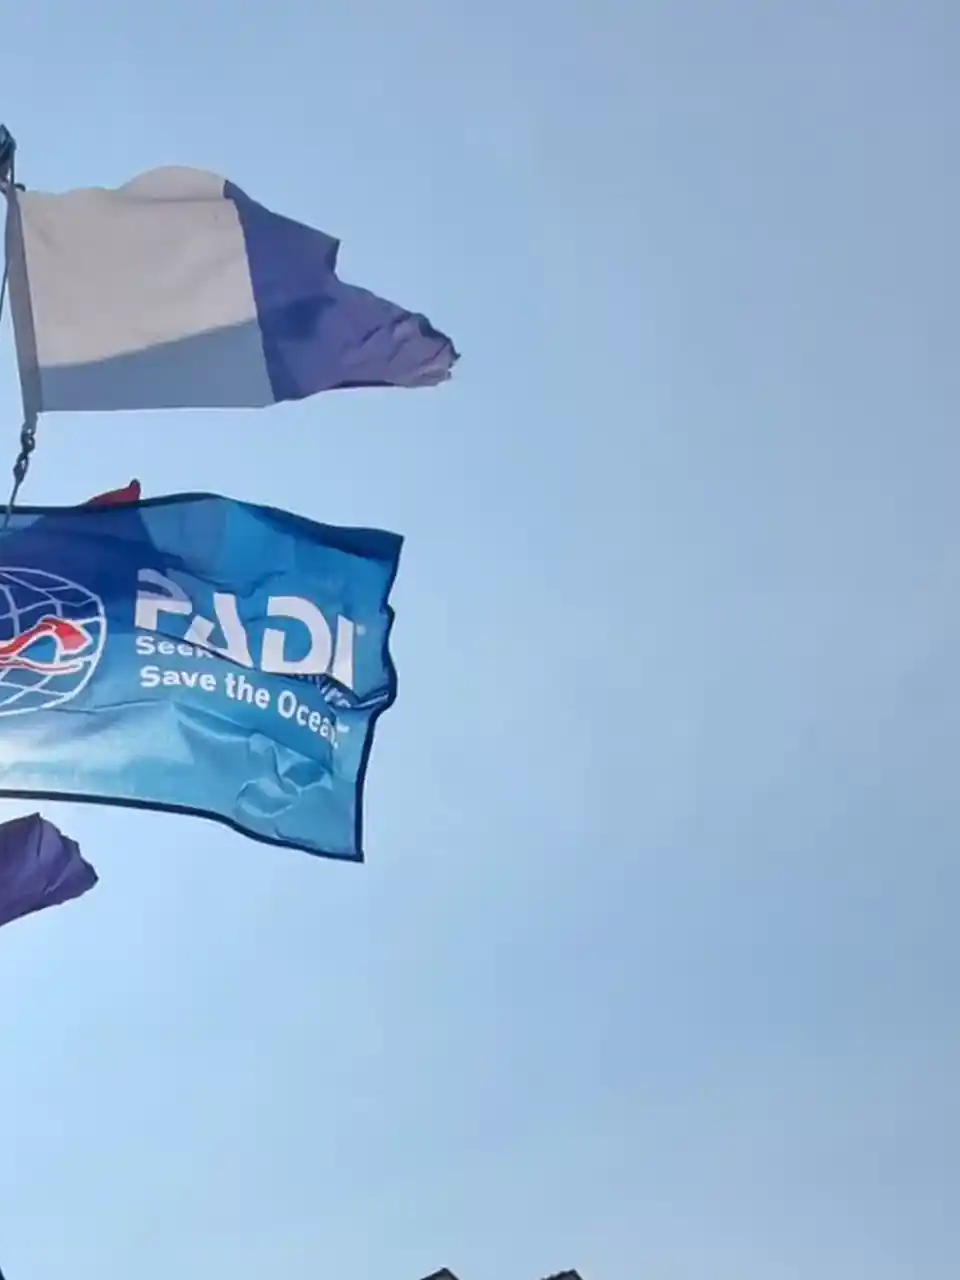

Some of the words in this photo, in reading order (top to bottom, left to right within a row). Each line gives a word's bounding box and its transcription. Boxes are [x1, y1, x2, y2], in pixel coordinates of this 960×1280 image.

[134, 567, 355, 690] PADI
[139, 665, 217, 692] Save
[224, 672, 272, 710] the
